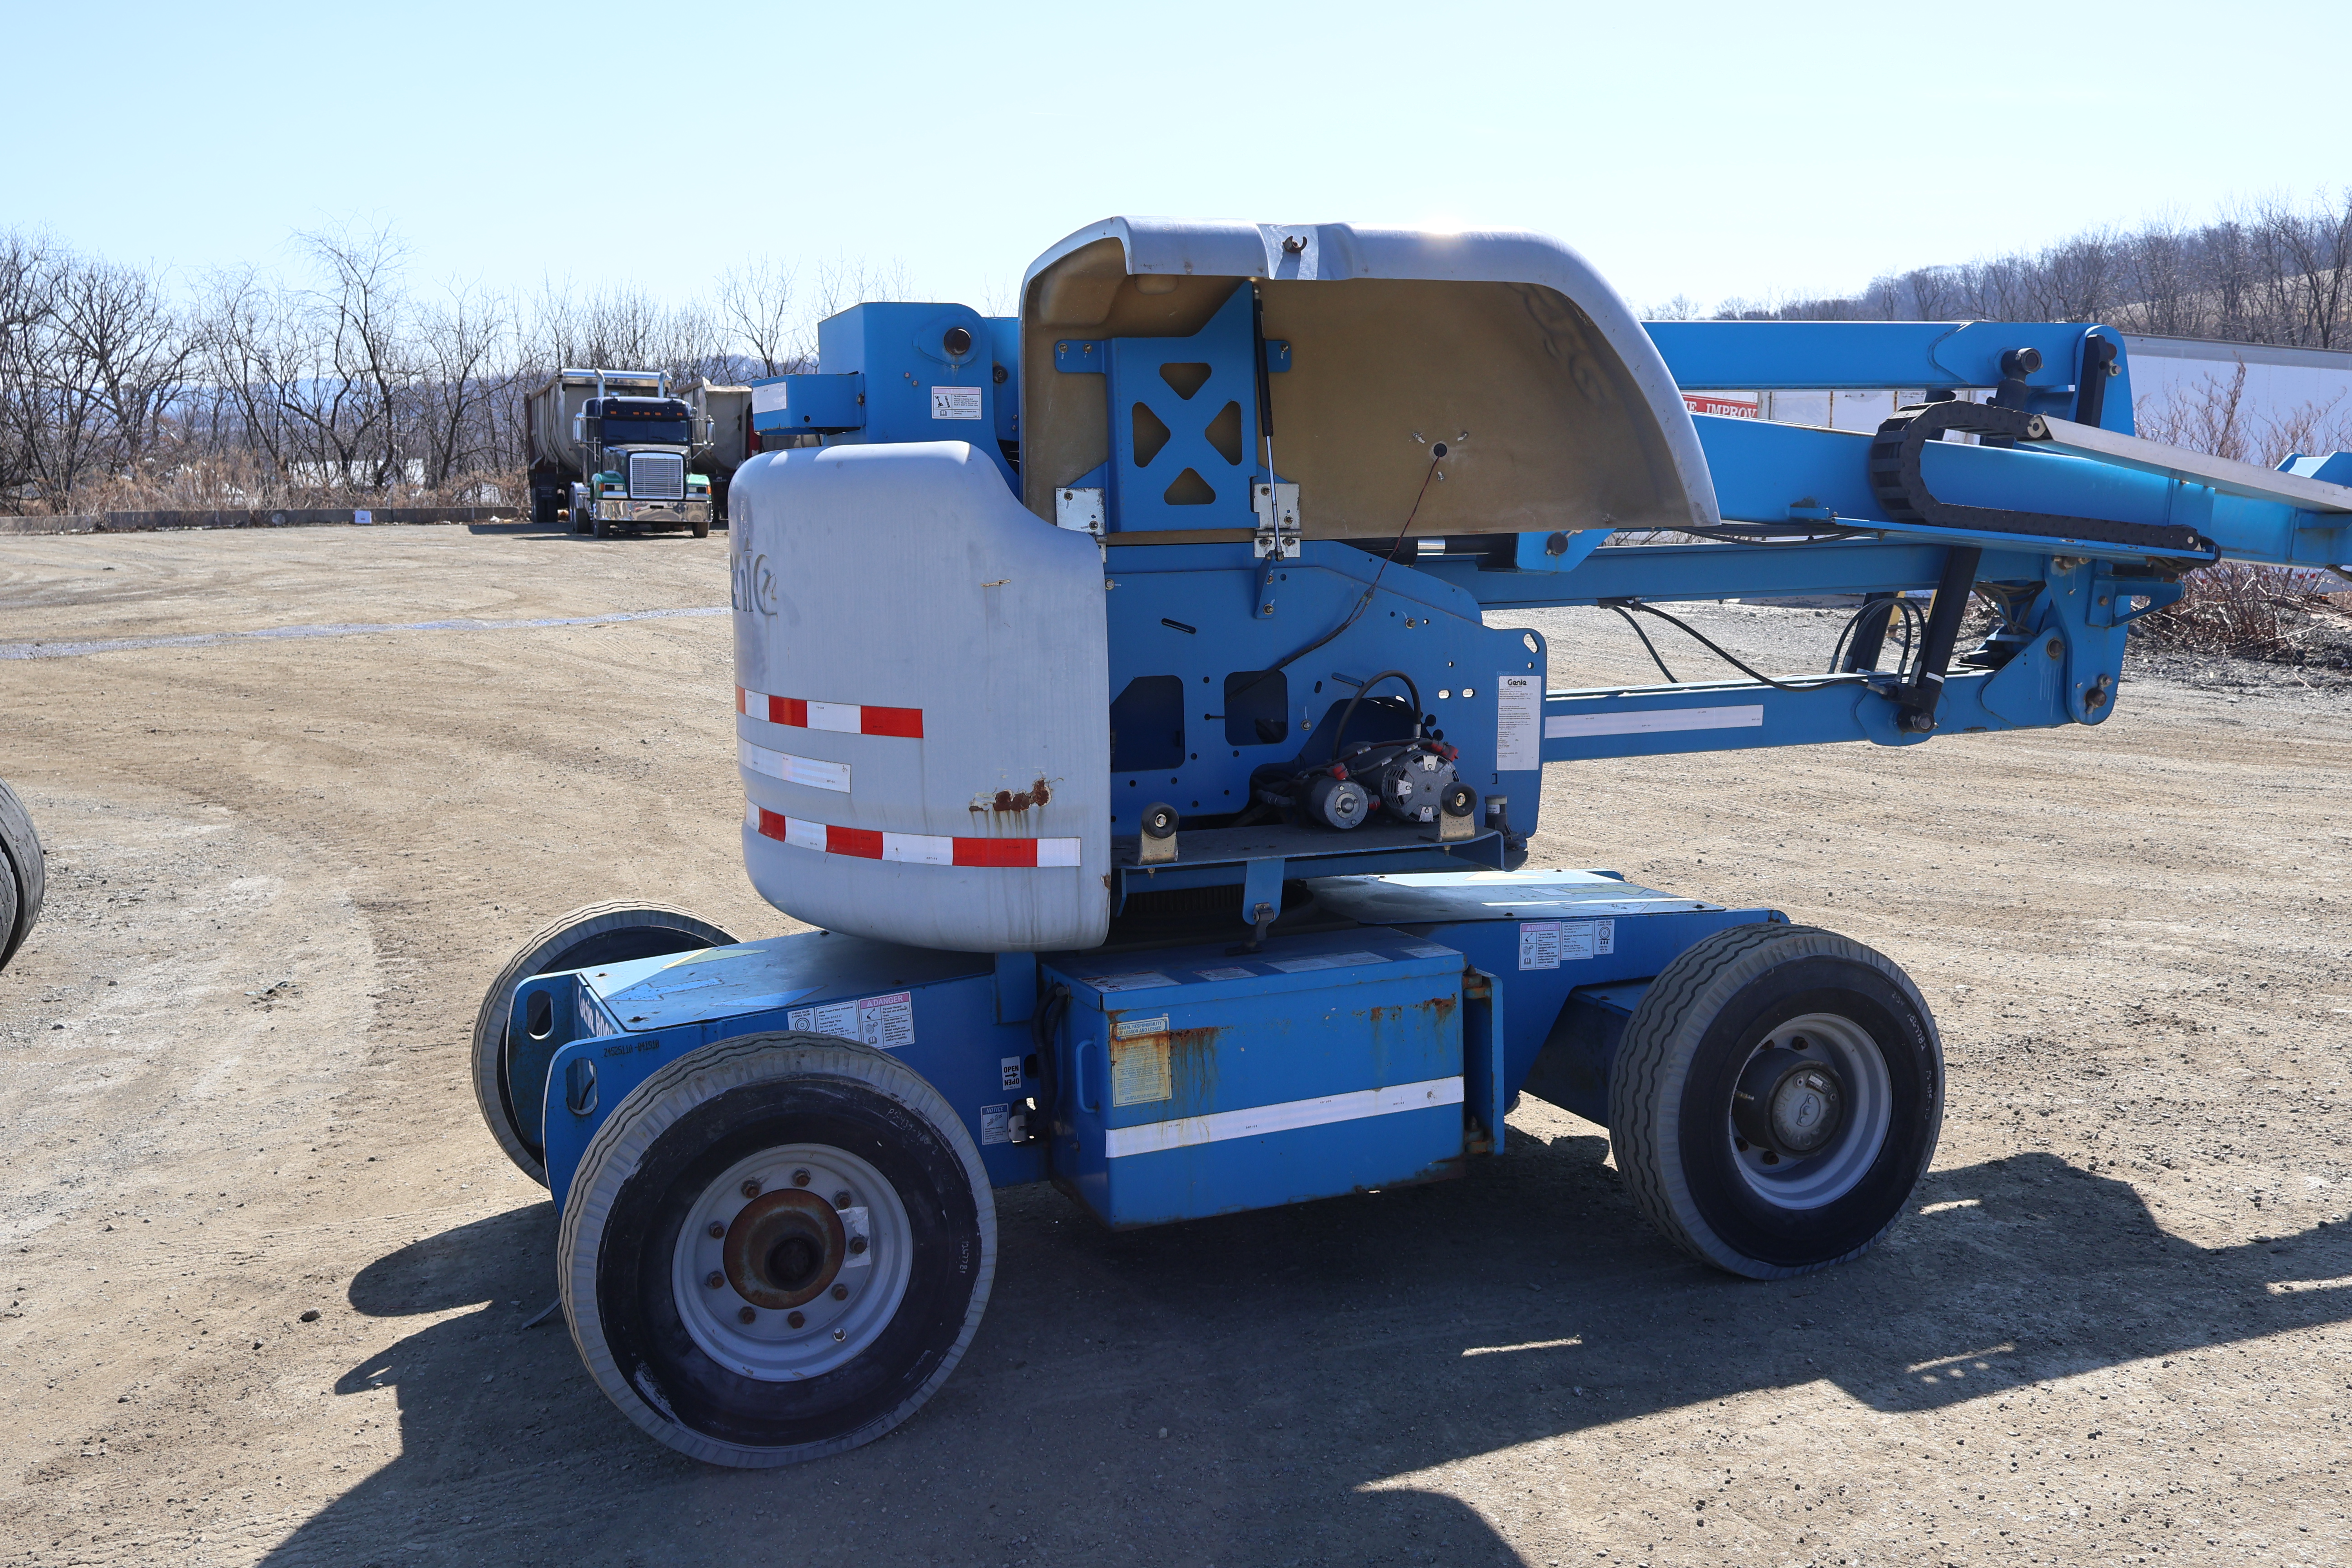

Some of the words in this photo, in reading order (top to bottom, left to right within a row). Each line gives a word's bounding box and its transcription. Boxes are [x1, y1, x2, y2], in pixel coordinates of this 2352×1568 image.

[873, 996, 903, 1006] DANGER
[578, 985, 595, 1035] Genie
[1004, 1065, 1019, 1073] OPEN
[1004, 1078, 1020, 1086] OPEN
